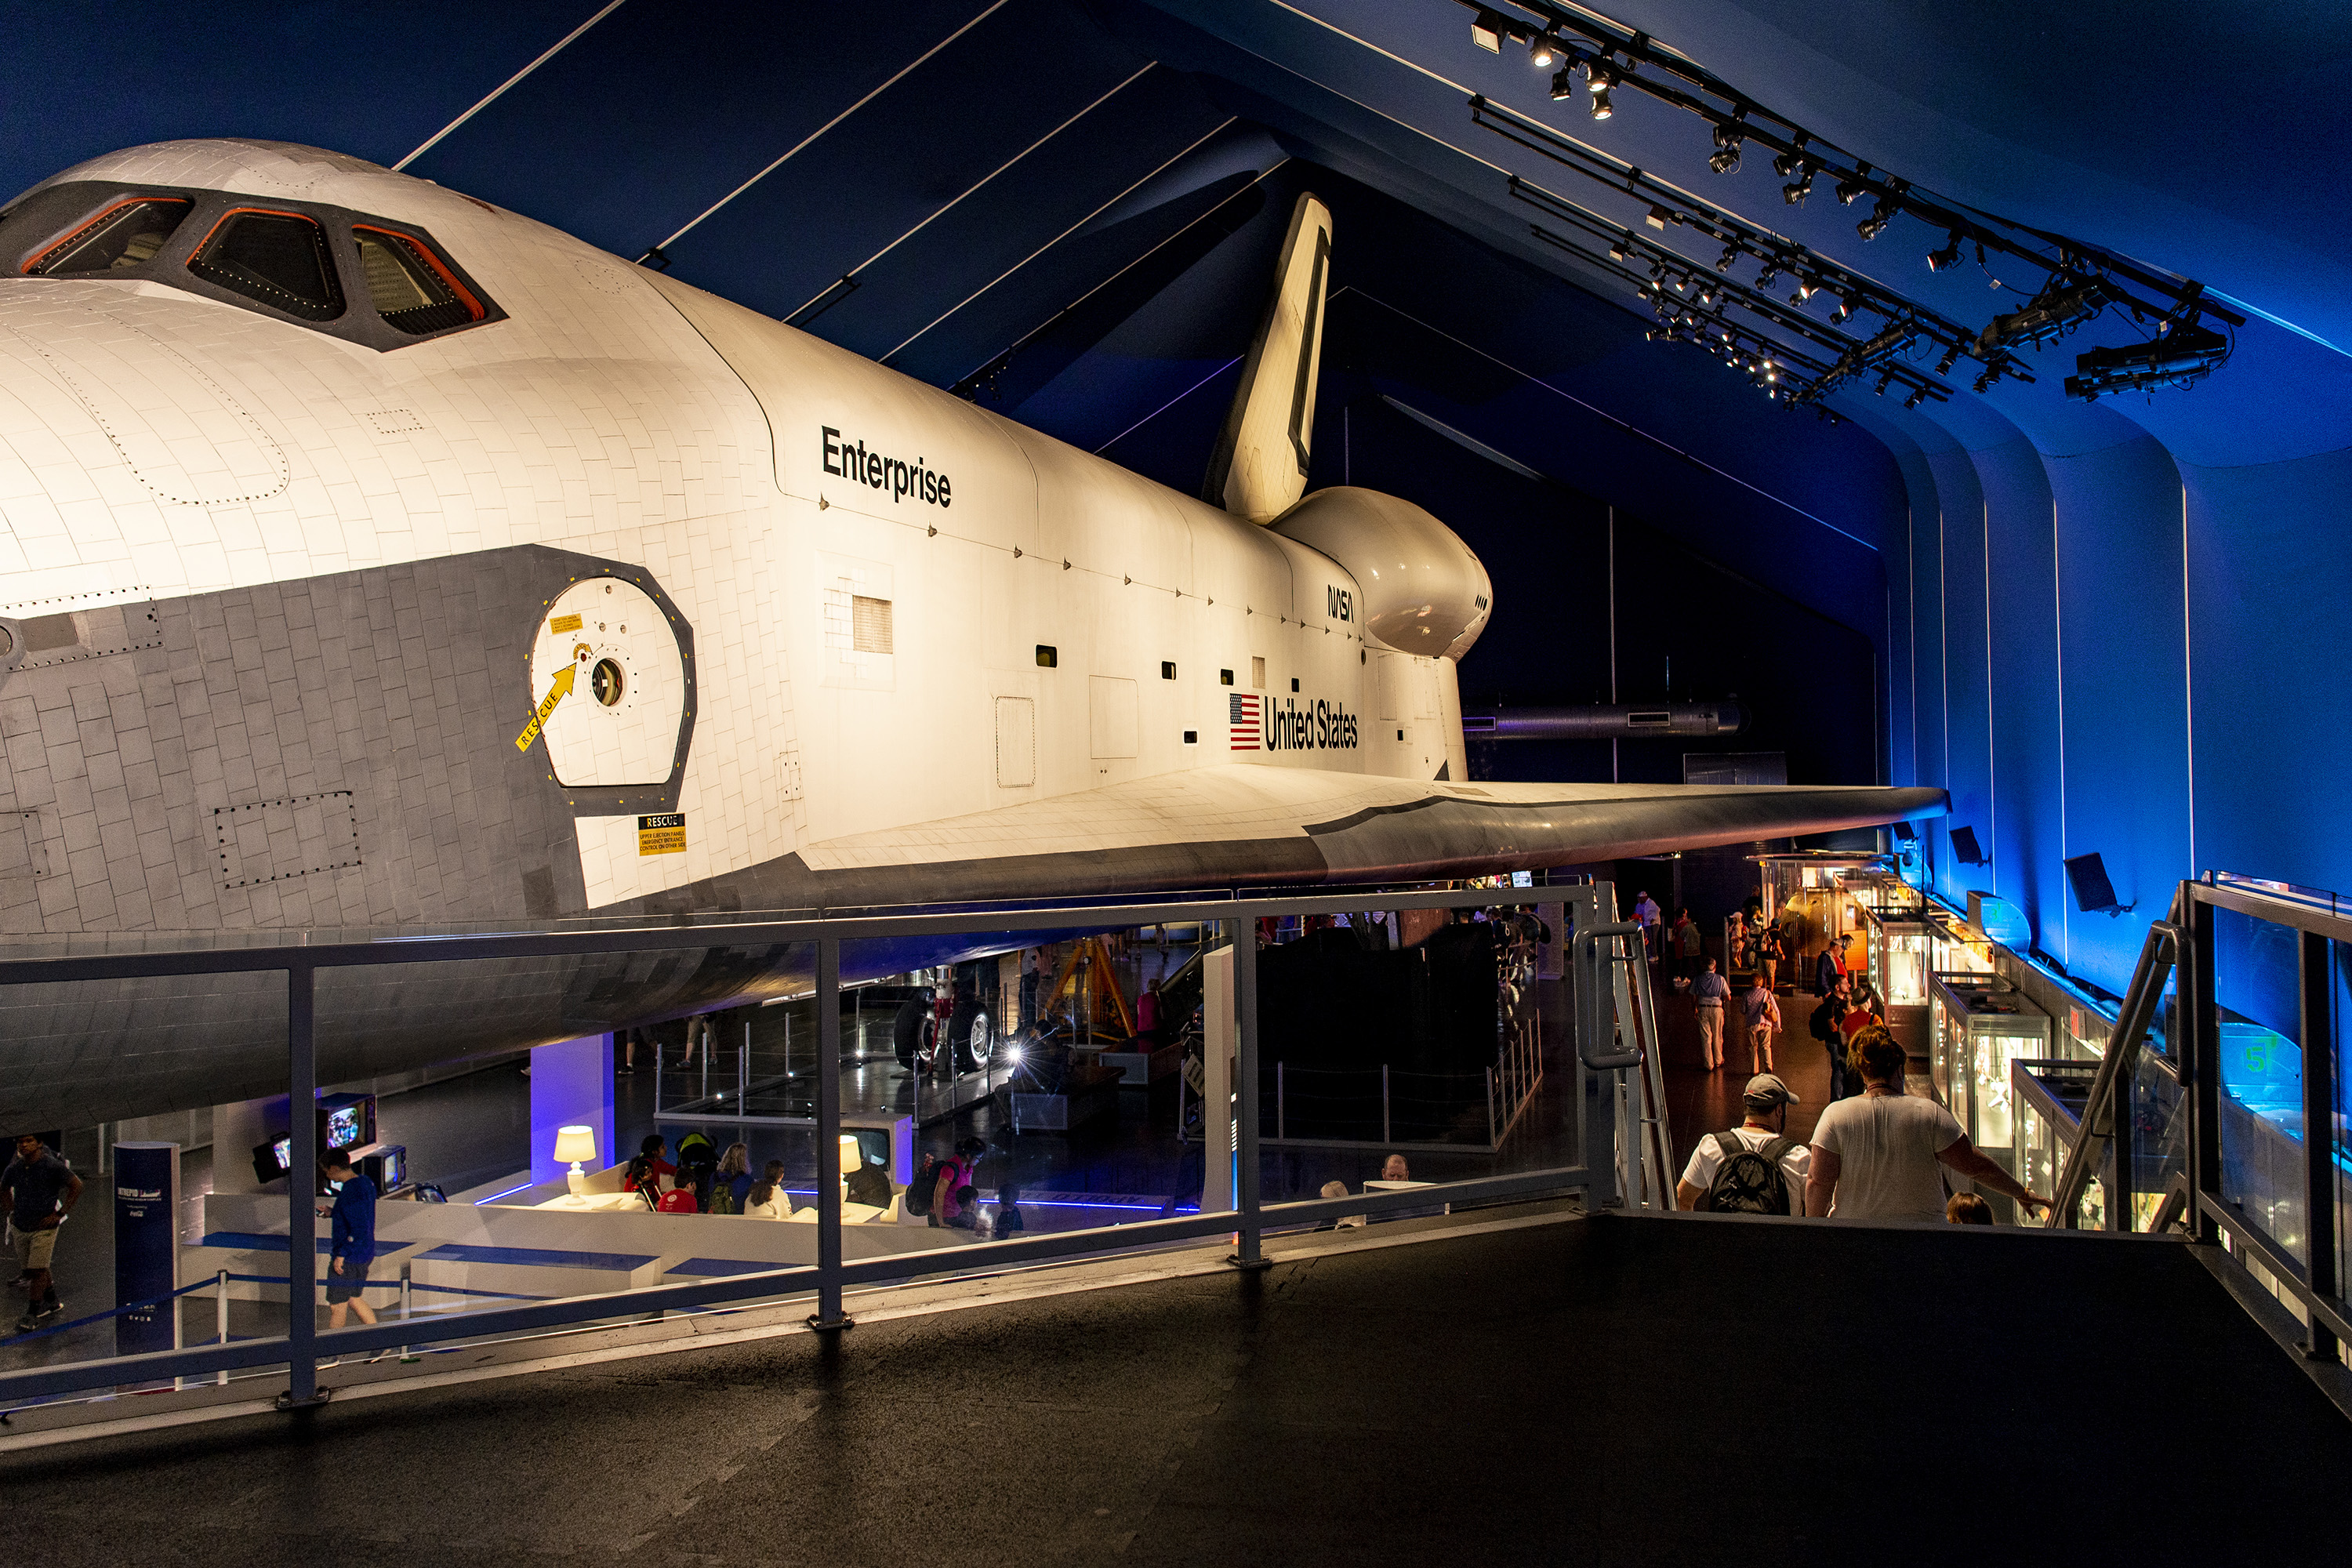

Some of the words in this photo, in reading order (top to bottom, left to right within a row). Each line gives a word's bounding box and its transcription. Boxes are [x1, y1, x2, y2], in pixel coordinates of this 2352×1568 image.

[821, 425, 952, 508] Enterprise
[1327, 584, 1354, 624] NASA
[521, 692, 558, 746] RESCUE
[1265, 695, 1314, 752] United
[1317, 699, 1358, 750] States
[647, 815, 677, 827] RESCUE
[2245, 1046, 2265, 1073] 5
